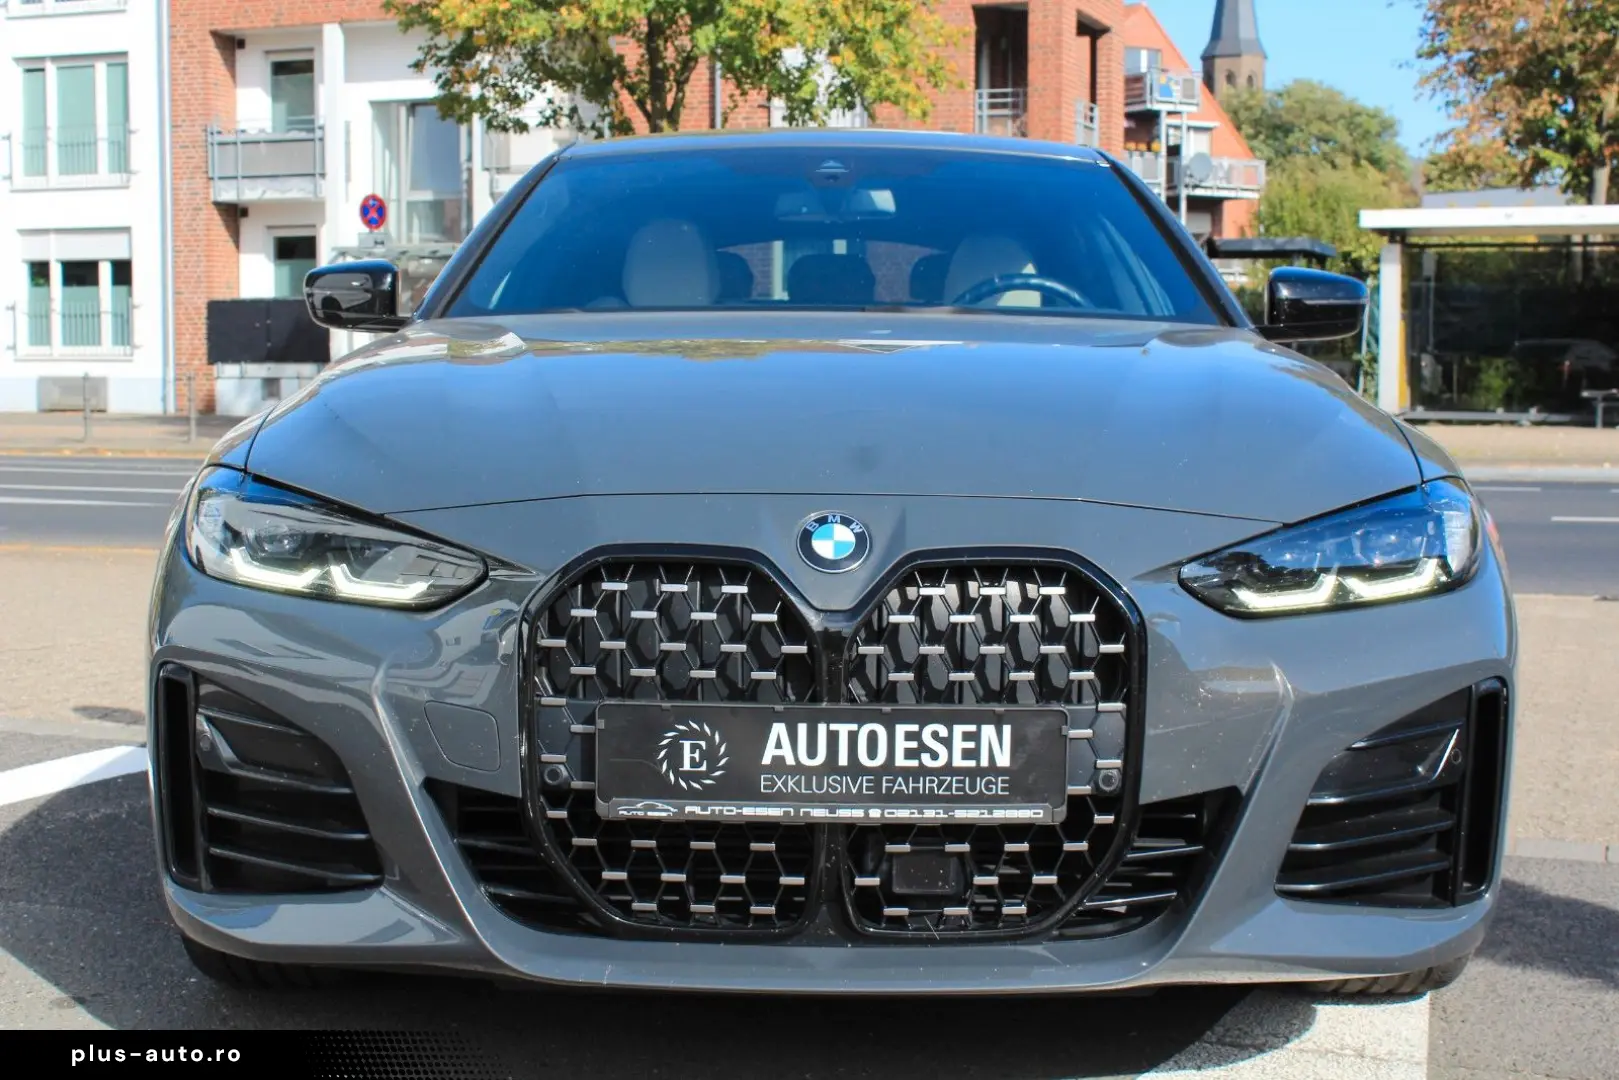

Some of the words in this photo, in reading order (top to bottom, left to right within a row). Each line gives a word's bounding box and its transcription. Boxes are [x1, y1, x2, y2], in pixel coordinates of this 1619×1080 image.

[805, 514, 863, 533] BMW
[679, 739, 707, 772] E
[760, 774, 875, 794] EXKLUSIVE
[882, 776, 1010, 795] FAHRZEUGE
